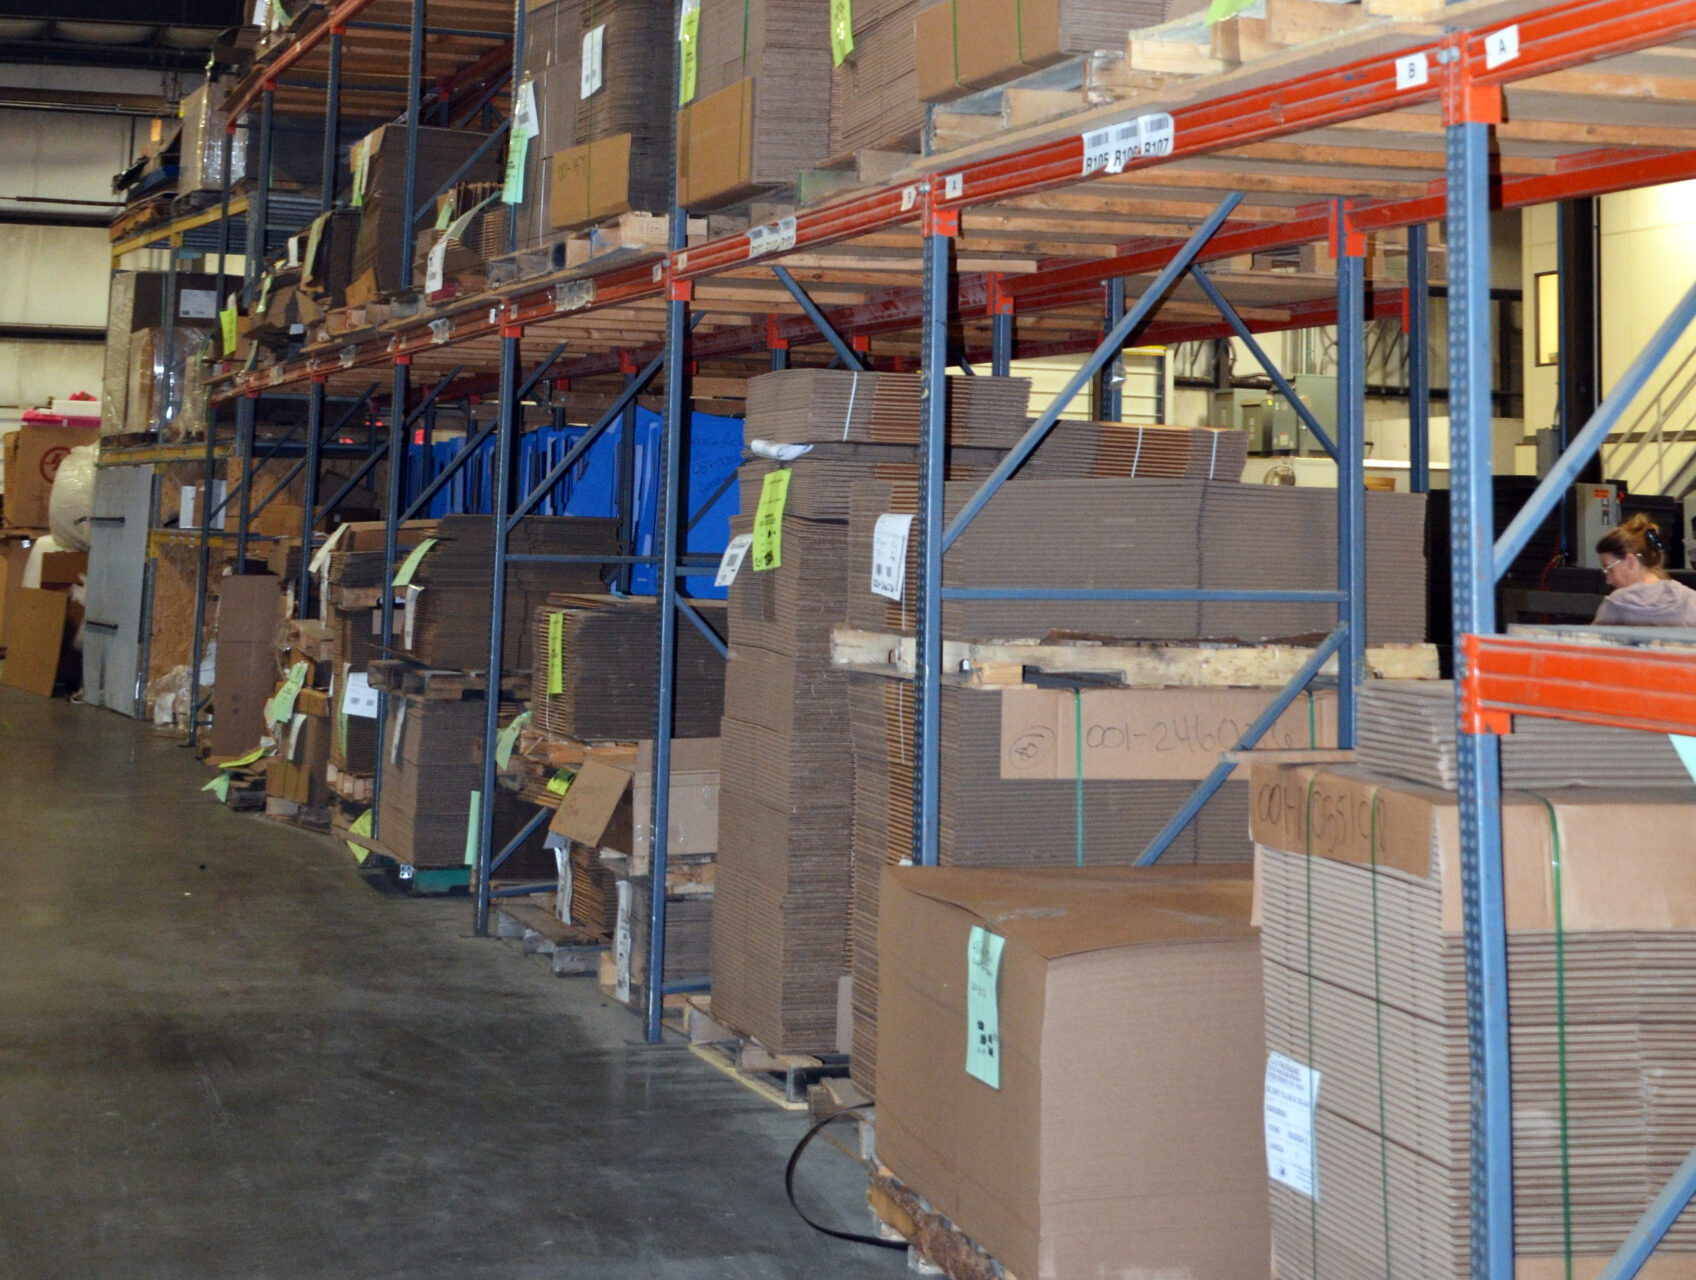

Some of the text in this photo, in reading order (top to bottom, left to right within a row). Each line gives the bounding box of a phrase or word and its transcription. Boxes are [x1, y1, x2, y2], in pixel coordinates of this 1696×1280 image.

[1497, 38, 1507, 56] A
[1407, 62, 1416, 80] B
[1143, 137, 1170, 156] R107
